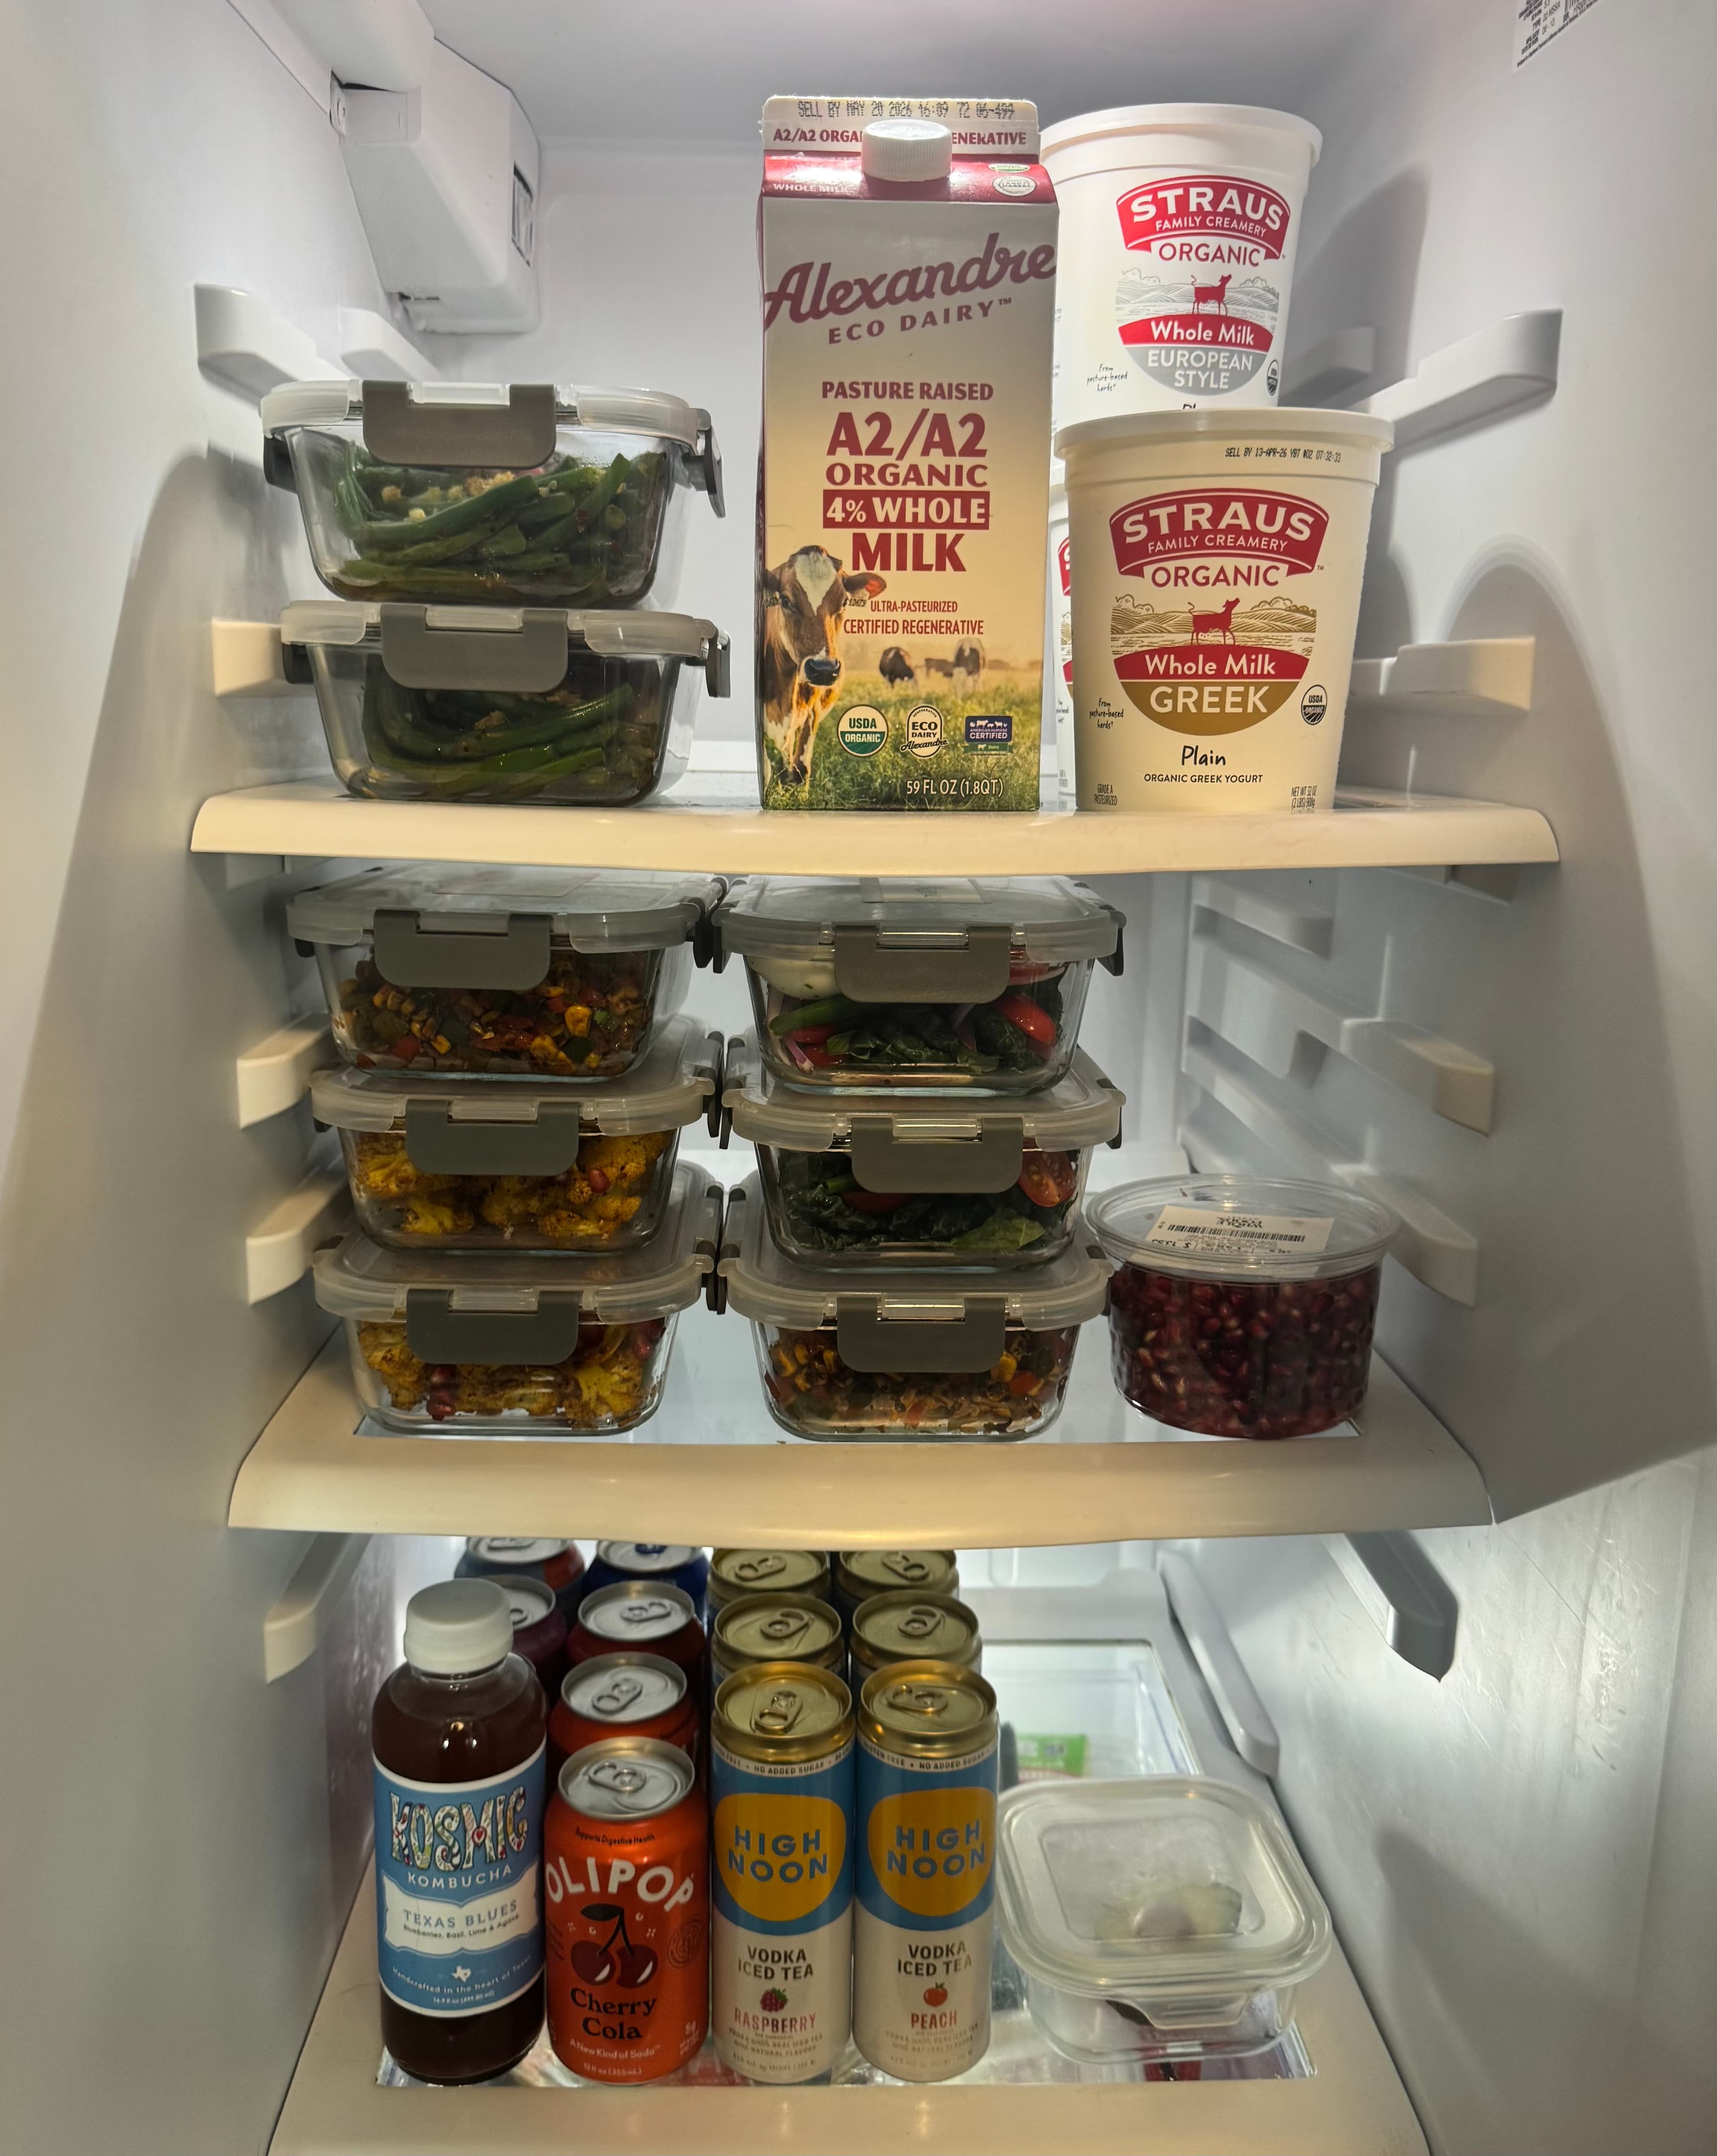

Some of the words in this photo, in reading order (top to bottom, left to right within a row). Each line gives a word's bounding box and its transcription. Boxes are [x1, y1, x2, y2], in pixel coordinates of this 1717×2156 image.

[798, 101, 822, 117] SELL
[828, 101, 840, 117] BY
[846, 100, 865, 116] MAY
[871, 101, 883, 116] 20
[888, 101, 912, 117] 2026
[957, 101, 970, 118] 72
[774, 128, 816, 142] A2/A2
[819, 130, 863, 143] ORGA
[773, 183, 816, 192] WHOLE
[1131, 187, 1284, 230] STRAUS
[1155, 216, 1202, 232] FAMILY
[1206, 216, 1266, 238] CREAMERY
[1159, 242, 1261, 267] ORGANIC
[764, 232, 1057, 332] Alexandre
[829, 320, 884, 344] ECO
[1151, 321, 1212, 342] Whole
[1218, 321, 1254, 346] Milk
[1148, 350, 1252, 371] EUROPEAN
[1174, 370, 1230, 389] STYLE
[822, 381, 913, 399] PASTURE
[920, 383, 994, 400] RAISED
[826, 408, 987, 461] A2/A2
[1225, 447, 1240, 457] SELL
[1244, 447, 1252, 457] BY
[1255, 447, 1287, 458] 13-APR-26
[826, 463, 988, 487] ORGANIC
[826, 497, 866, 523] 4%
[872, 497, 985, 524] WHOLE
[1123, 502, 1315, 544] STRAUS
[852, 533, 966, 572] MILK
[1148, 535, 1199, 554] FAMILY
[1205, 535, 1287, 552] CREAMERY
[1151, 565, 1280, 587] ORGANIC
[871, 600, 958, 613] ULTRA-PASTEURIZED
[844, 619, 899, 634] CERTIFIED
[902, 620, 984, 635] REGENERATIVE
[1145, 654, 1217, 675] Whole
[1224, 654, 1276, 675] Milk
[1099, 697, 1111, 707] From
[1150, 686, 1269, 713] GREEK
[1309, 695, 1323, 703] USDA
[849, 718, 877, 729] USDA
[912, 721, 938, 730] ECO
[845, 733, 880, 743] ORGANIC
[901, 738, 948, 751] Alexandre
[1181, 745, 1226, 766] Plain
[907, 780, 921, 795] 59
[923, 780, 938, 795] FL
[940, 780, 958, 795] OZ
[960, 778, 1004, 798] (1.8QT)
[1144, 774, 1188, 783] ORGANIC
[1190, 774, 1222, 783] GREEK
[1224, 774, 1263, 783] YOGURT
[1110, 785, 1113, 794] A
[1291, 786, 1300, 797] NET
[768, 1767, 796, 1775] ADDED
[799, 1761, 824, 1773] SUGAR
[919, 1761, 931, 1769] NO
[934, 1760, 960, 1770] ADDED
[390, 1785, 529, 1872] KOSMIC
[896, 1819, 980, 1851] HIGH
[735, 1825, 820, 1856] HIGH
[728, 1848, 828, 1883] NOON
[887, 1843, 984, 1879] NOON
[408, 1864, 512, 1890] KOMBUCHA
[546, 1856, 694, 1912] OLIPOP
[404, 1909, 456, 1928] TEXAS
[465, 1900, 517, 1926] BLUES
[469, 1928, 486, 1936] Lime
[748, 1943, 807, 1964] VODKA
[908, 1940, 966, 1960] VODKA
[738, 1958, 775, 1980] ICED
[781, 1963, 813, 1981] TEA
[897, 1958, 937, 1976] ICED
[943, 1954, 972, 1975] TEA
[392, 1966, 440, 1993] Handcrafted
[457, 1985, 471, 1993] the
[475, 1977, 499, 1990] heart
[501, 1970, 510, 1980] of
[570, 1987, 657, 2017] Cherry
[582, 2017, 642, 2040] Cola
[735, 2007, 816, 2033] RASPBERRY
[911, 2010, 957, 2029] PEACH
[570, 2038, 576, 2047] A
[596, 2048, 617, 2059] Kind
[619, 2050, 628, 2059] of
